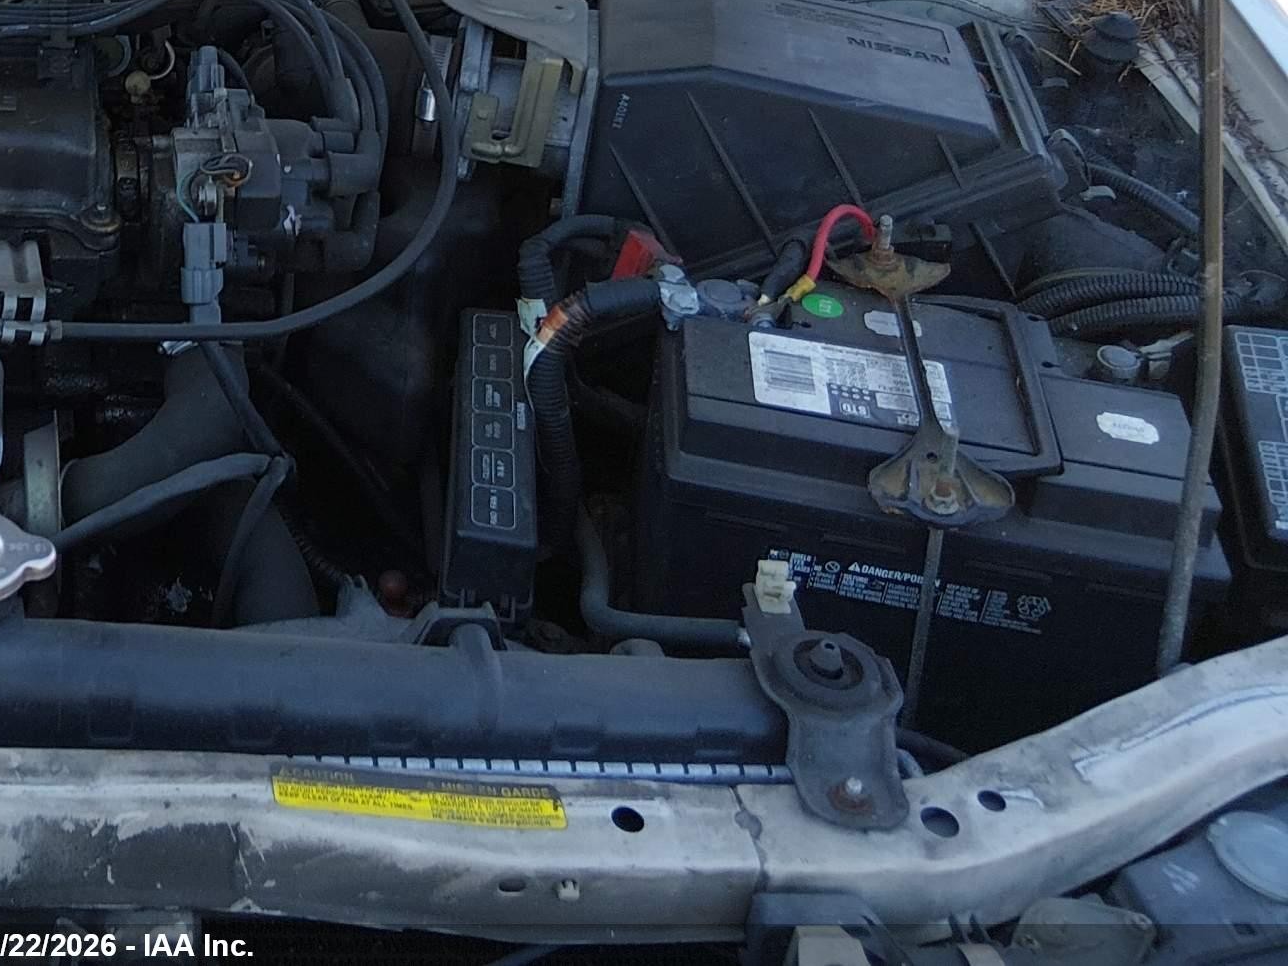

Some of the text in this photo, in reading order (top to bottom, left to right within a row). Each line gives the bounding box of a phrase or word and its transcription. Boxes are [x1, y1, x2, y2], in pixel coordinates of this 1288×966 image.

[846, 36, 951, 65] NISSAN
[293, 769, 354, 783] CAUTION
[478, 785, 496, 795] EN
[501, 786, 550, 799] GARDE
